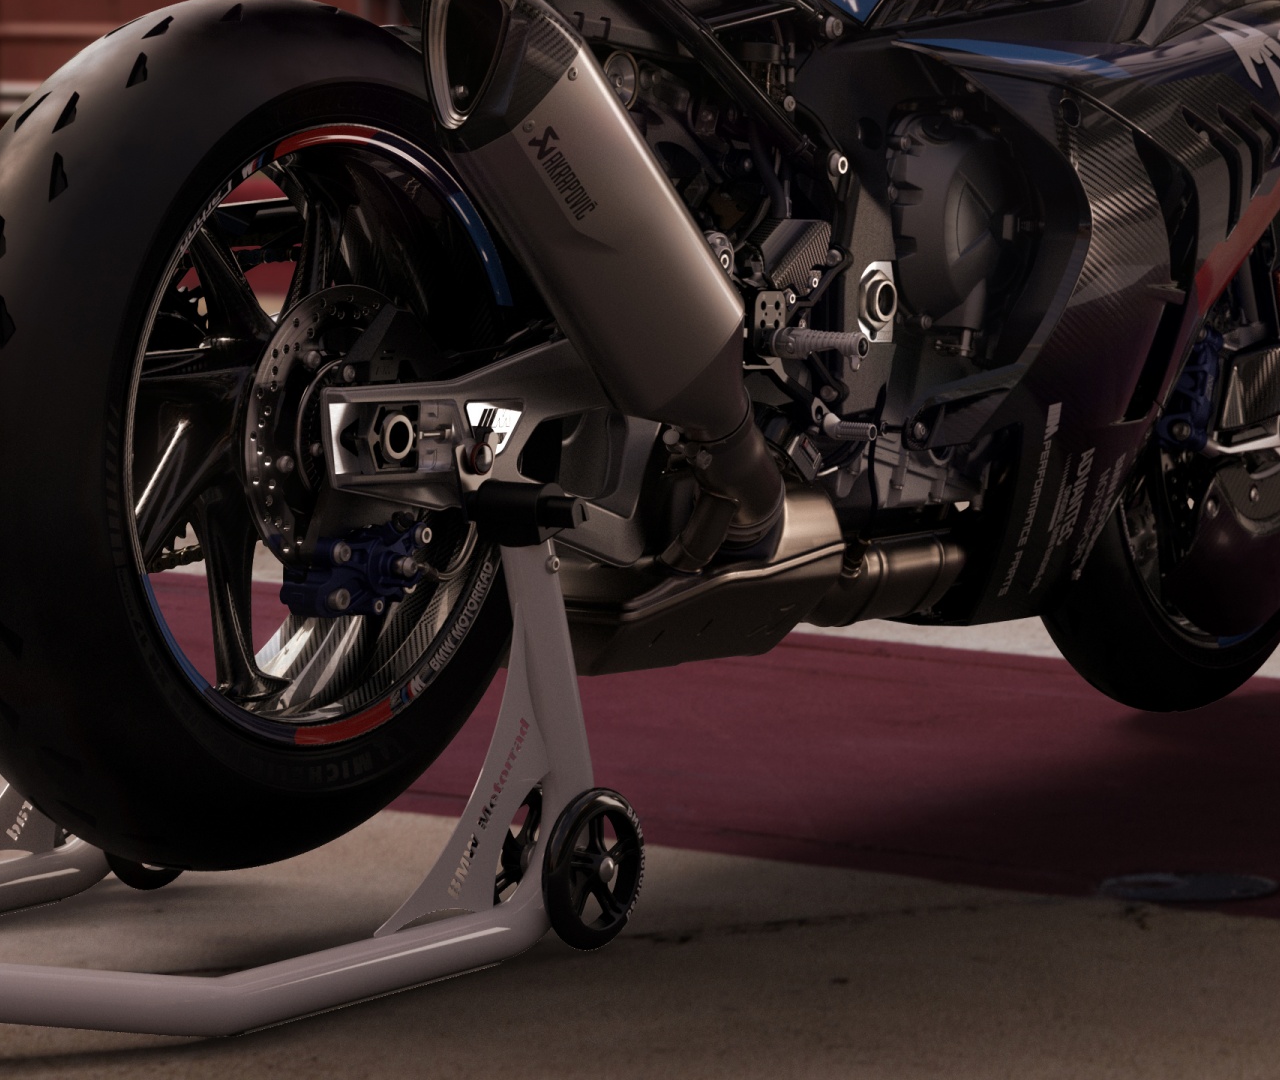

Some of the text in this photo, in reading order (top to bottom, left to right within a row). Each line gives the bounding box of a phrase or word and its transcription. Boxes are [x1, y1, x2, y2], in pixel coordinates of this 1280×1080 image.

[542, 150, 598, 221] AKRAPOVIČ
[1016, 439, 1053, 548] PERFORMANCE
[1056, 446, 1096, 547] ADVANTEC
[429, 636, 456, 672] BMW
[451, 560, 494, 640] MOTORRAD
[996, 549, 1024, 598] PARTS
[446, 716, 531, 900] BMW Motorrad
[626, 804, 644, 839] BMW
